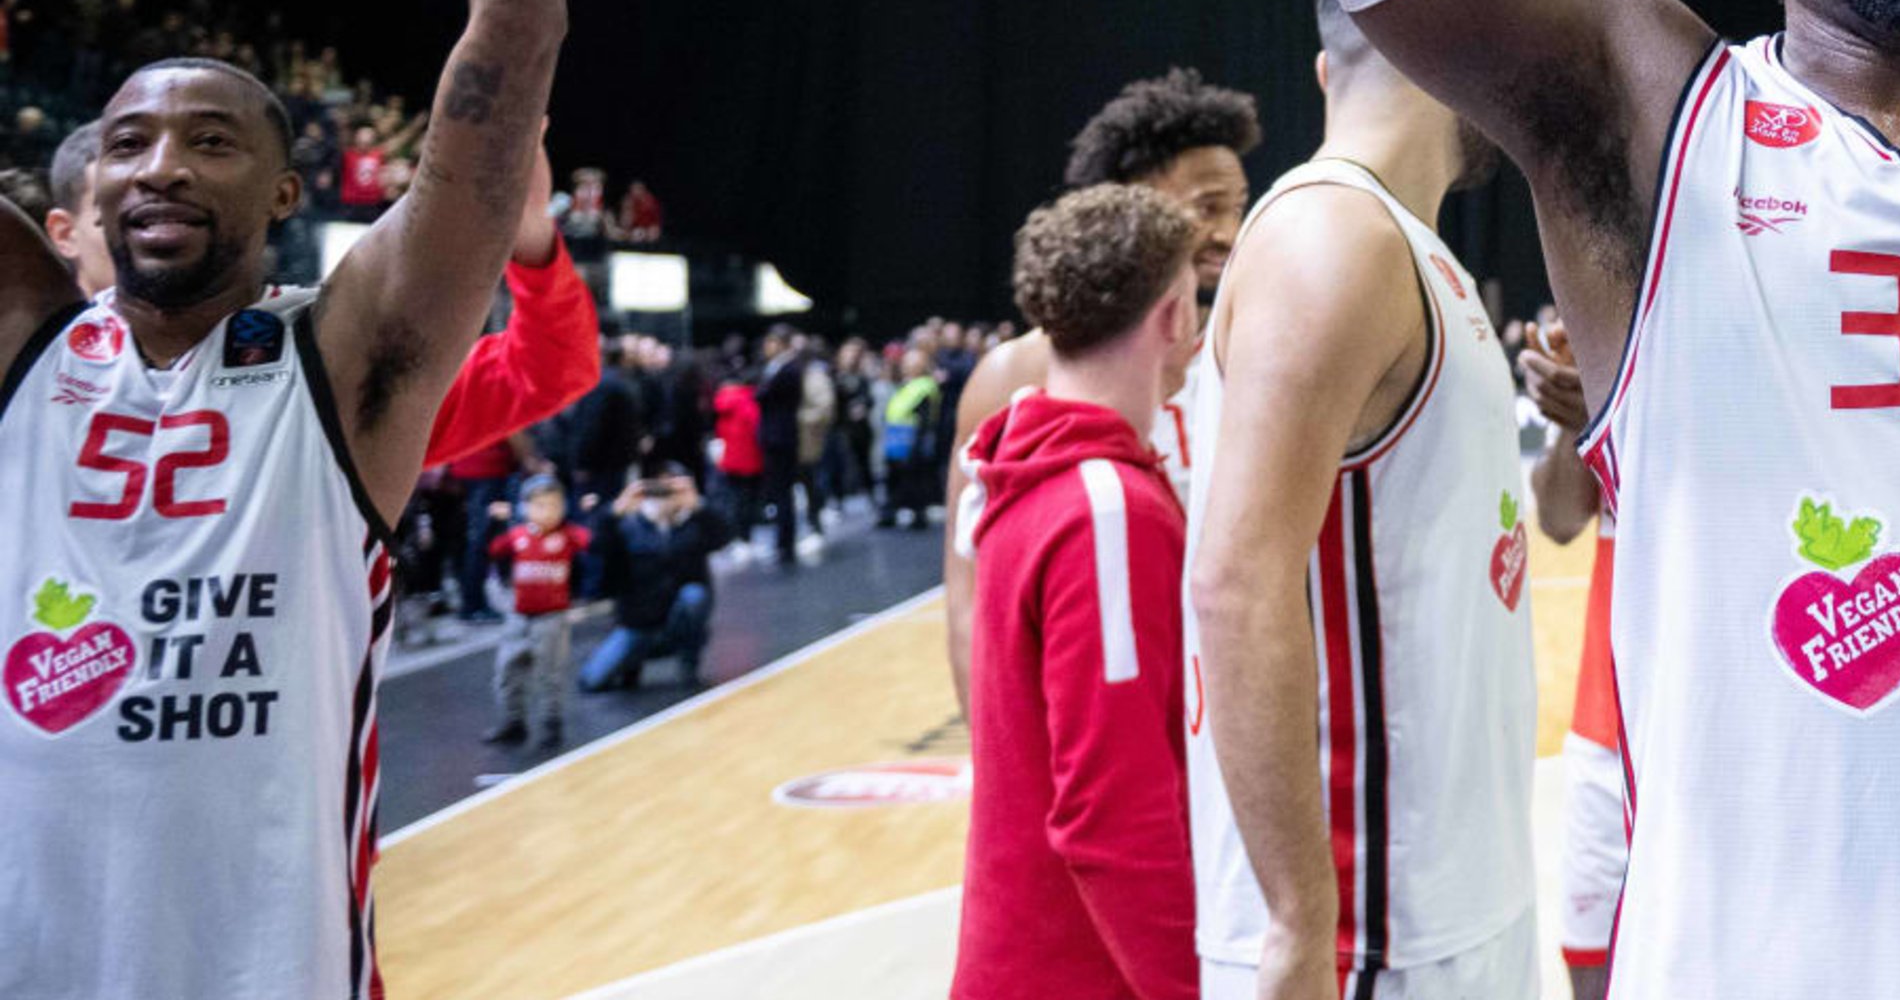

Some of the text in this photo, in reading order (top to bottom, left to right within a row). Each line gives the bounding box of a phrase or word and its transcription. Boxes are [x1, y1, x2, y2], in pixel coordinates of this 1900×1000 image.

[67, 409, 231, 521] 52
[141, 573, 278, 624] GIVE
[148, 632, 262, 680] IT A
[117, 691, 279, 742] SHOT
